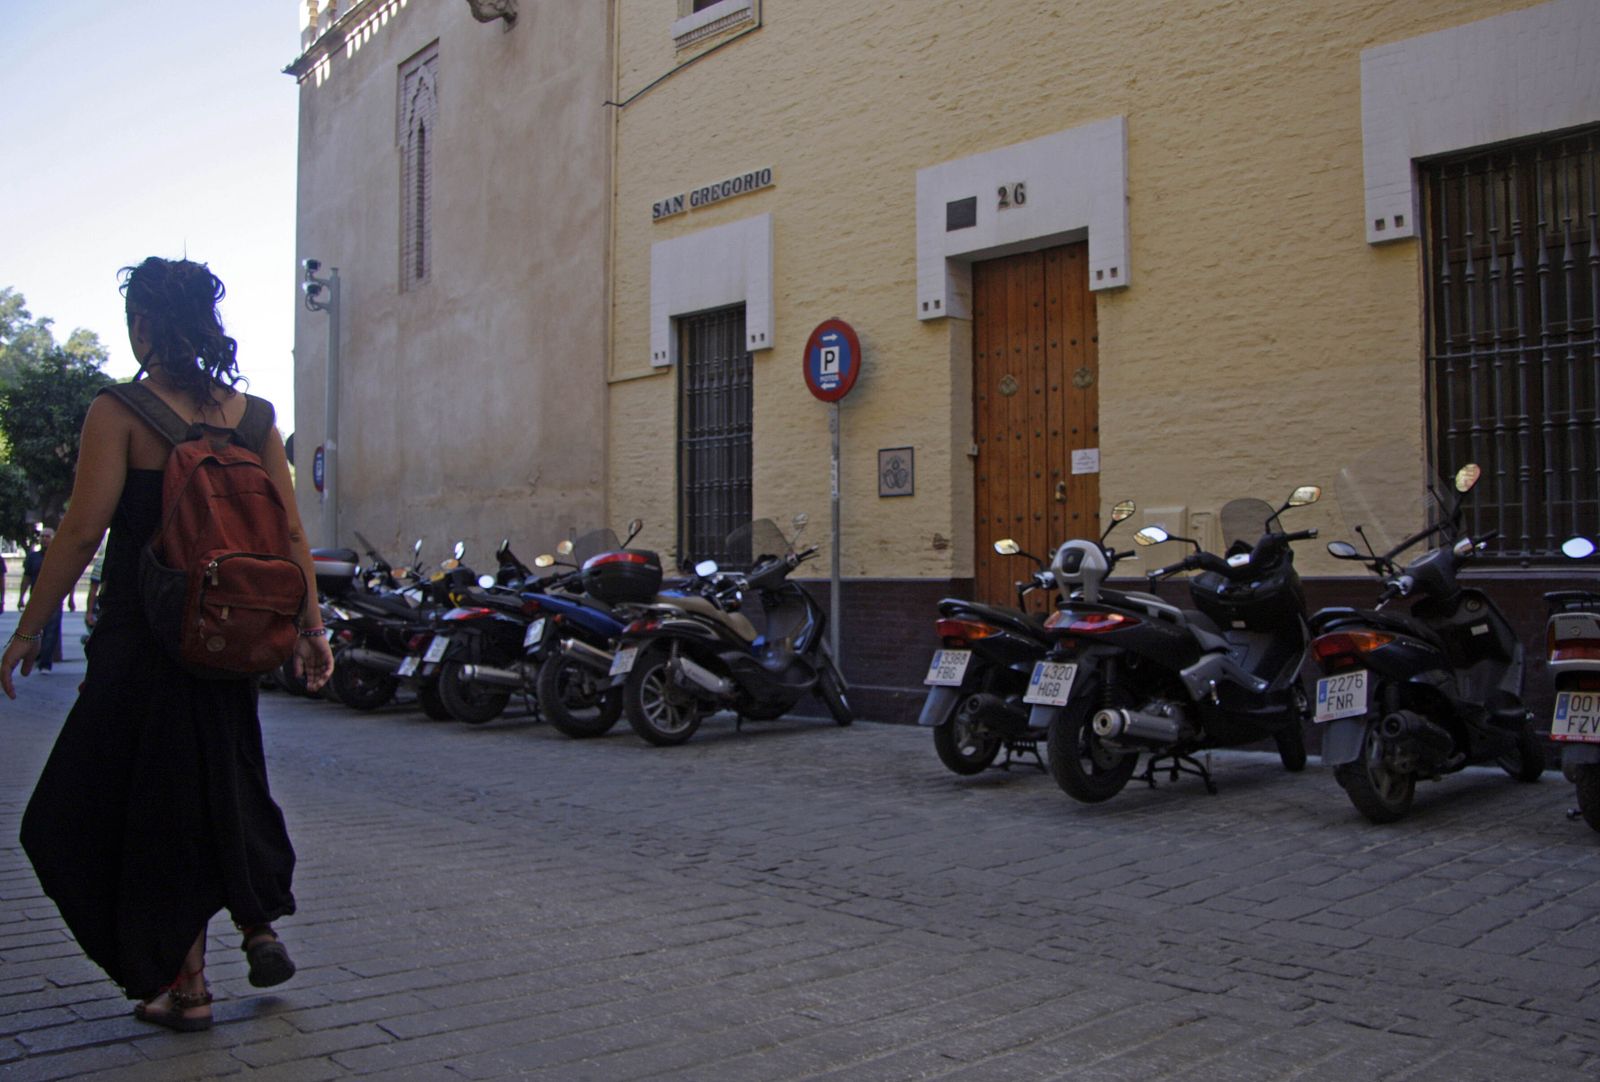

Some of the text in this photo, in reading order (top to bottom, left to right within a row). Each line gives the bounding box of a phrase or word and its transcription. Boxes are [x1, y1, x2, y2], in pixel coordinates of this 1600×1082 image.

[652, 167, 772, 220] SAN GREGORIO
[998, 182, 1026, 208] 26
[824, 350, 836, 372] P
[1042, 664, 1074, 681] 4320
[1036, 681, 1062, 698] HGB
[1329, 673, 1364, 694] 2276
[1327, 692, 1354, 712] FNR
[1567, 715, 1600, 734] FZV
